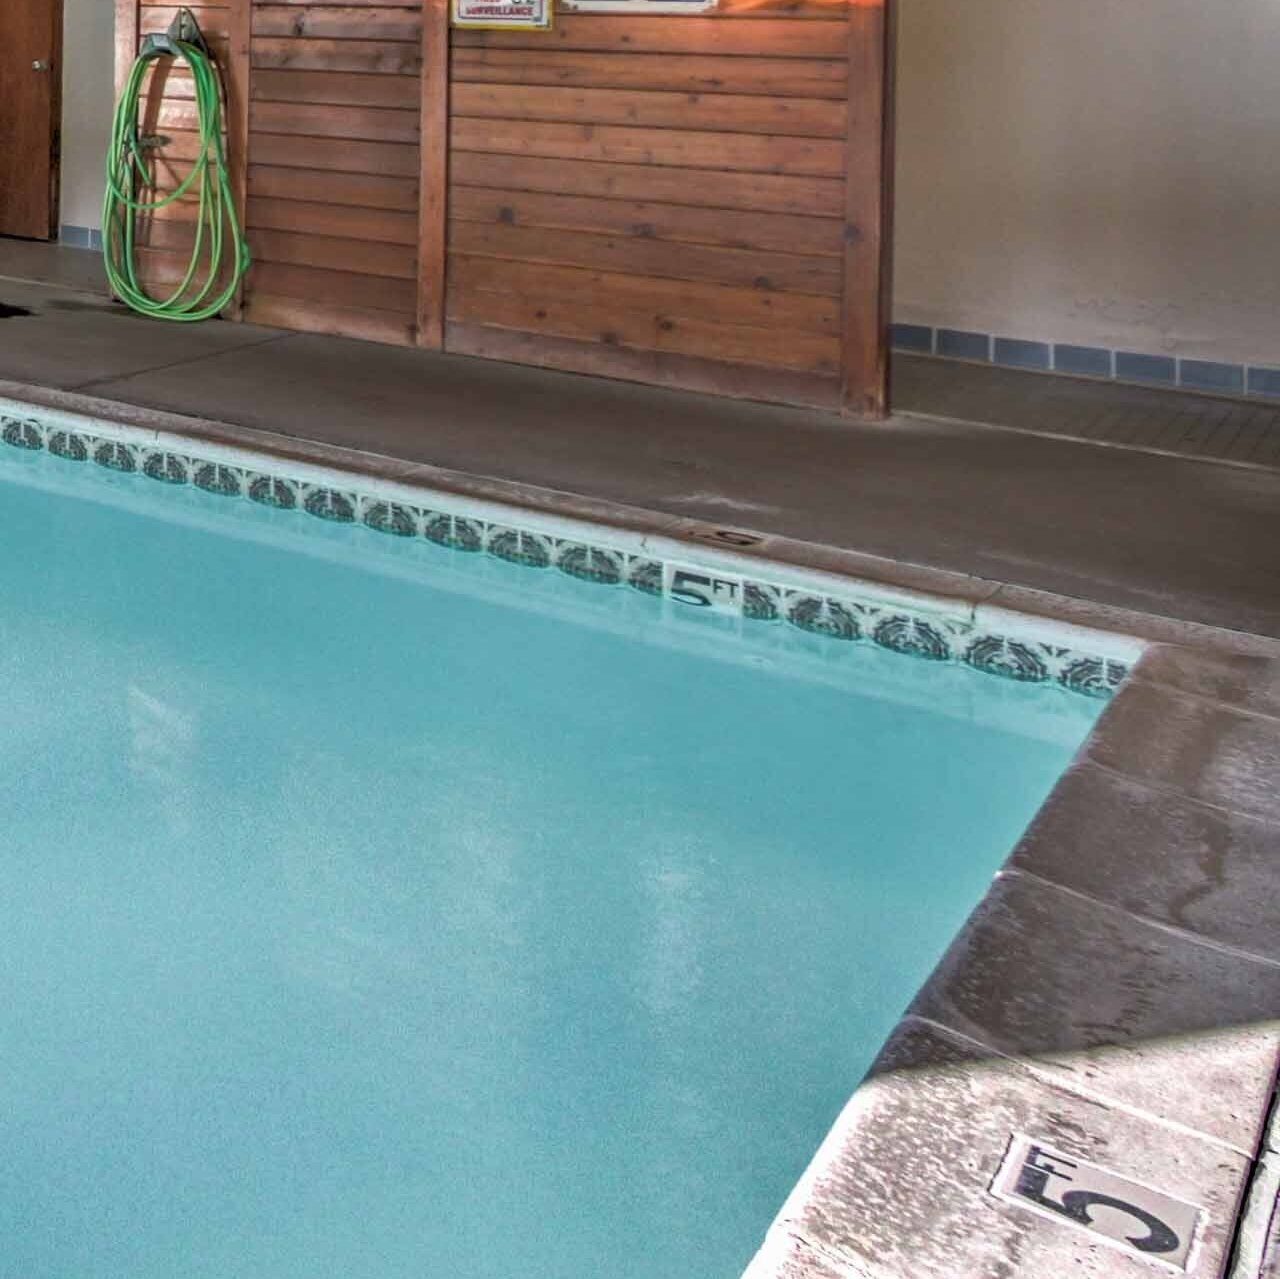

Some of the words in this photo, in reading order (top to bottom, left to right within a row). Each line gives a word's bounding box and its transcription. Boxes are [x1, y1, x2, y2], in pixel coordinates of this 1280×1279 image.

[466, 6, 533, 17] SURVEILLANCE
[671, 570, 712, 606] 5
[713, 579, 739, 598] FT
[1013, 1163, 1181, 1253] 5
